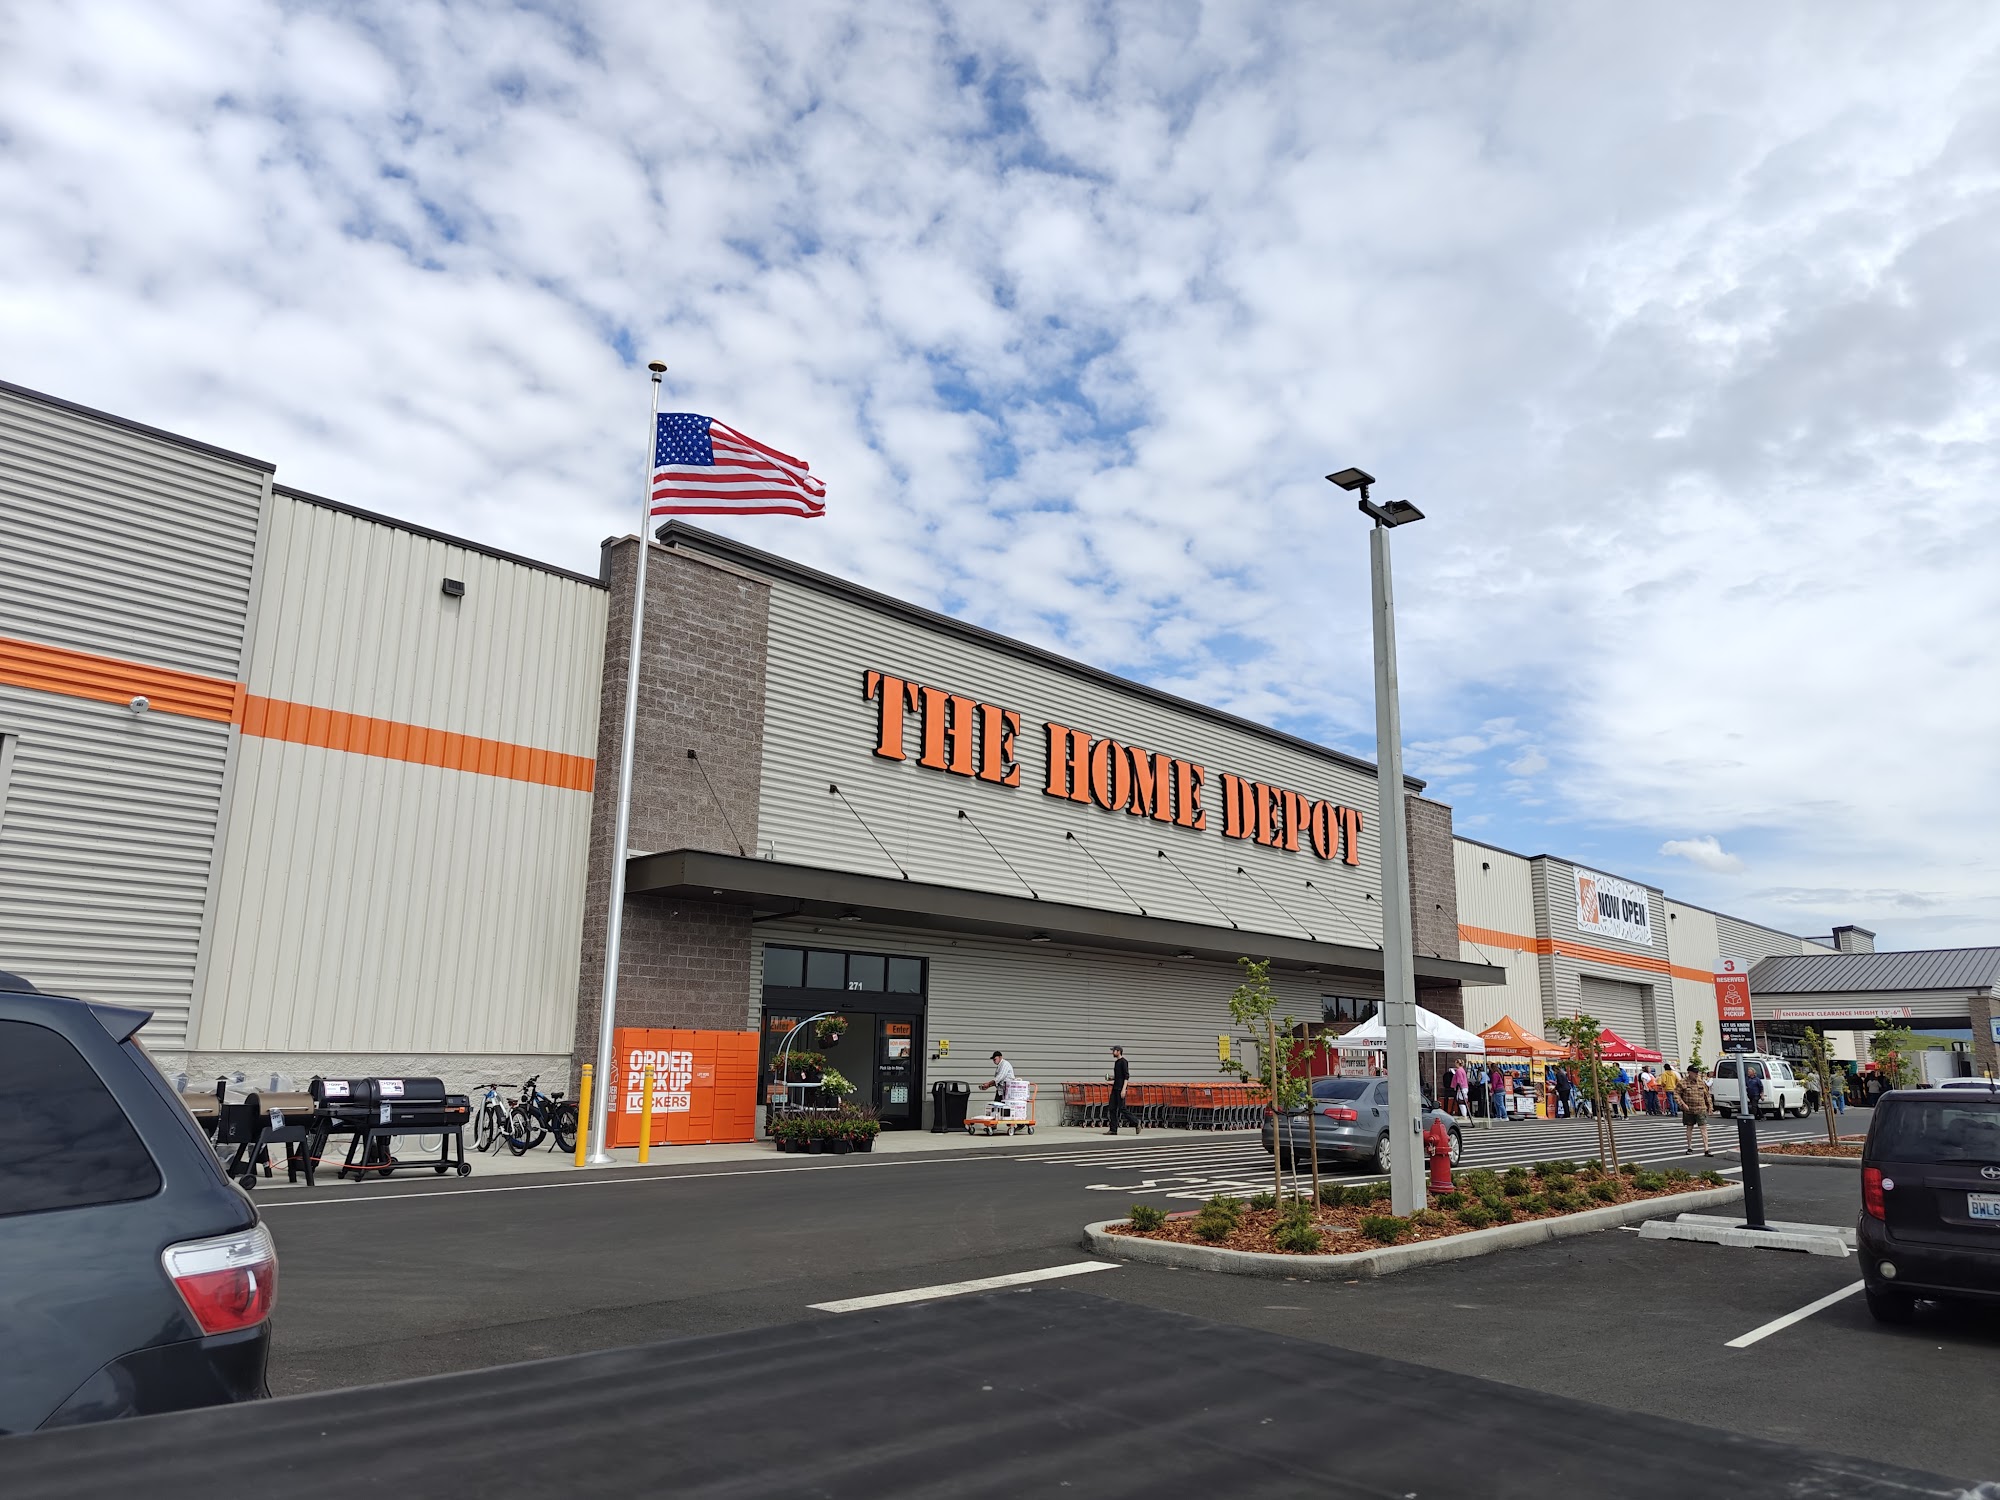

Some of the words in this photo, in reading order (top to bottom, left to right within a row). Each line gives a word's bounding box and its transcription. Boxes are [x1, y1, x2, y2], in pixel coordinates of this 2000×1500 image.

[863, 669, 1021, 788] THE
[1042, 722, 1207, 831] HOME
[1219, 773, 1364, 866] DEPOT
[1598, 891, 1620, 920] NOW
[1622, 898, 1646, 927] OPEN
[1724, 960, 1735, 971] 3
[849, 981, 864, 991] 271
[892, 1025, 910, 1034] Enter
[629, 1050, 693, 1072] ORDER
